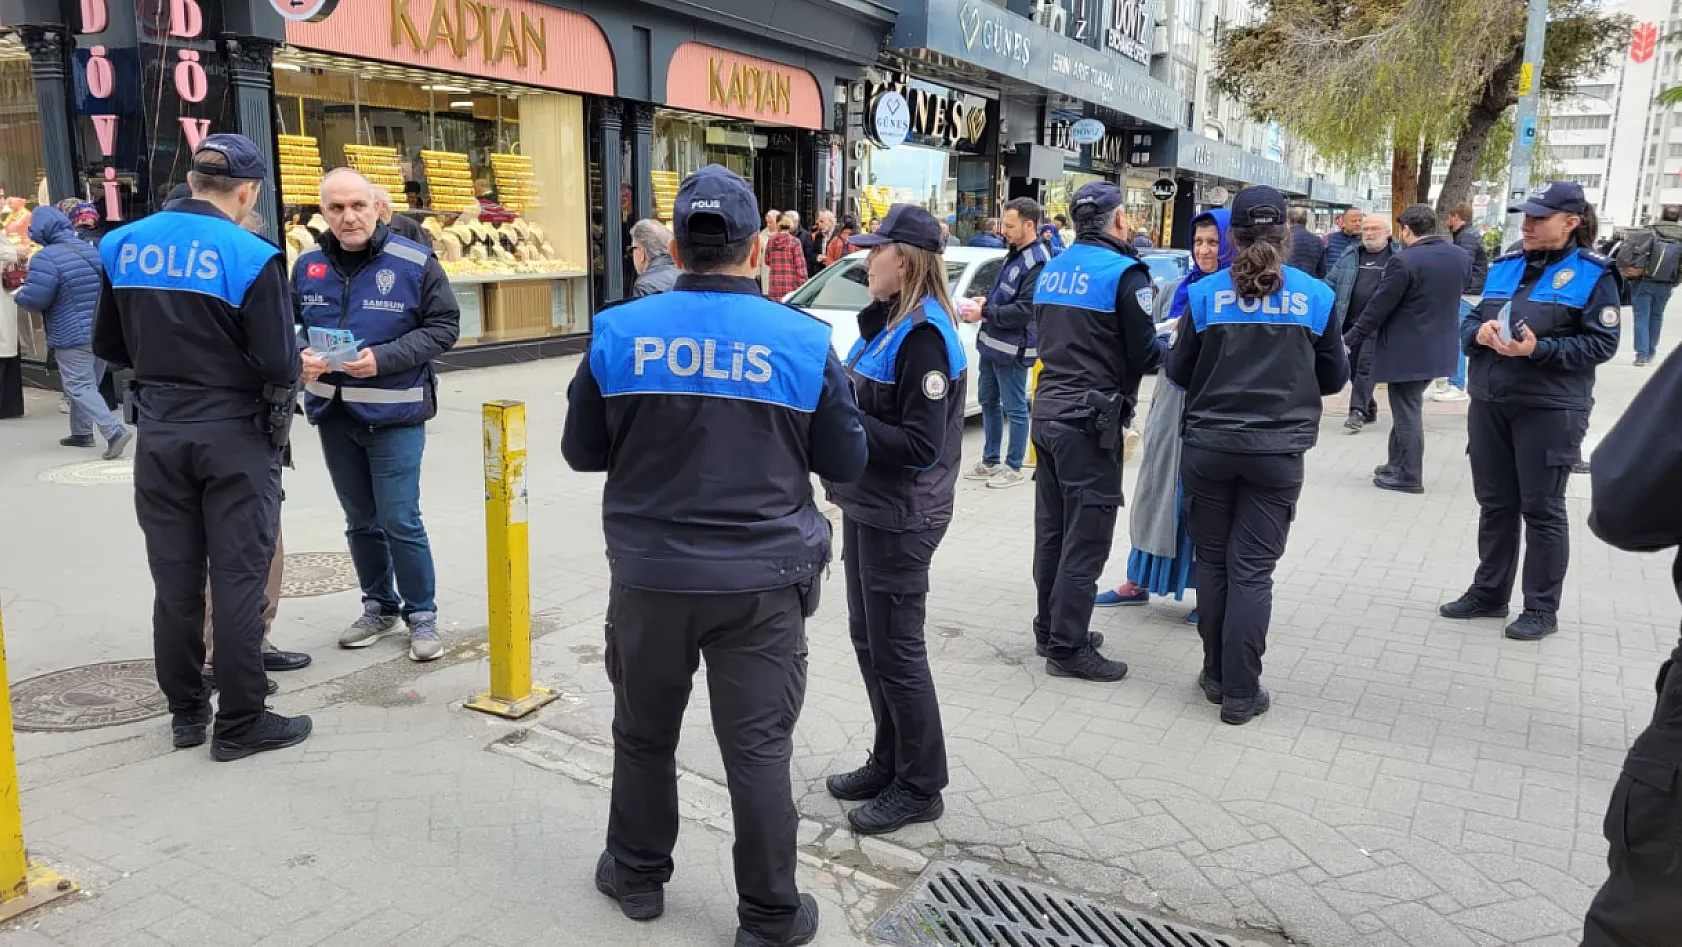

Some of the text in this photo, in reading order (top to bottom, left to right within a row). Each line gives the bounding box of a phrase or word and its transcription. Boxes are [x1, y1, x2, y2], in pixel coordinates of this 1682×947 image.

[390, 0, 547, 71] KAPTAN
[981, 16, 1031, 69] GÜNEŞ
[708, 57, 791, 115] KAPTAN
[119, 240, 219, 280] POLİS
[1036, 265, 1090, 295] POLİS
[362, 299, 405, 310] SAMSUN
[634, 336, 773, 383] POLİS
